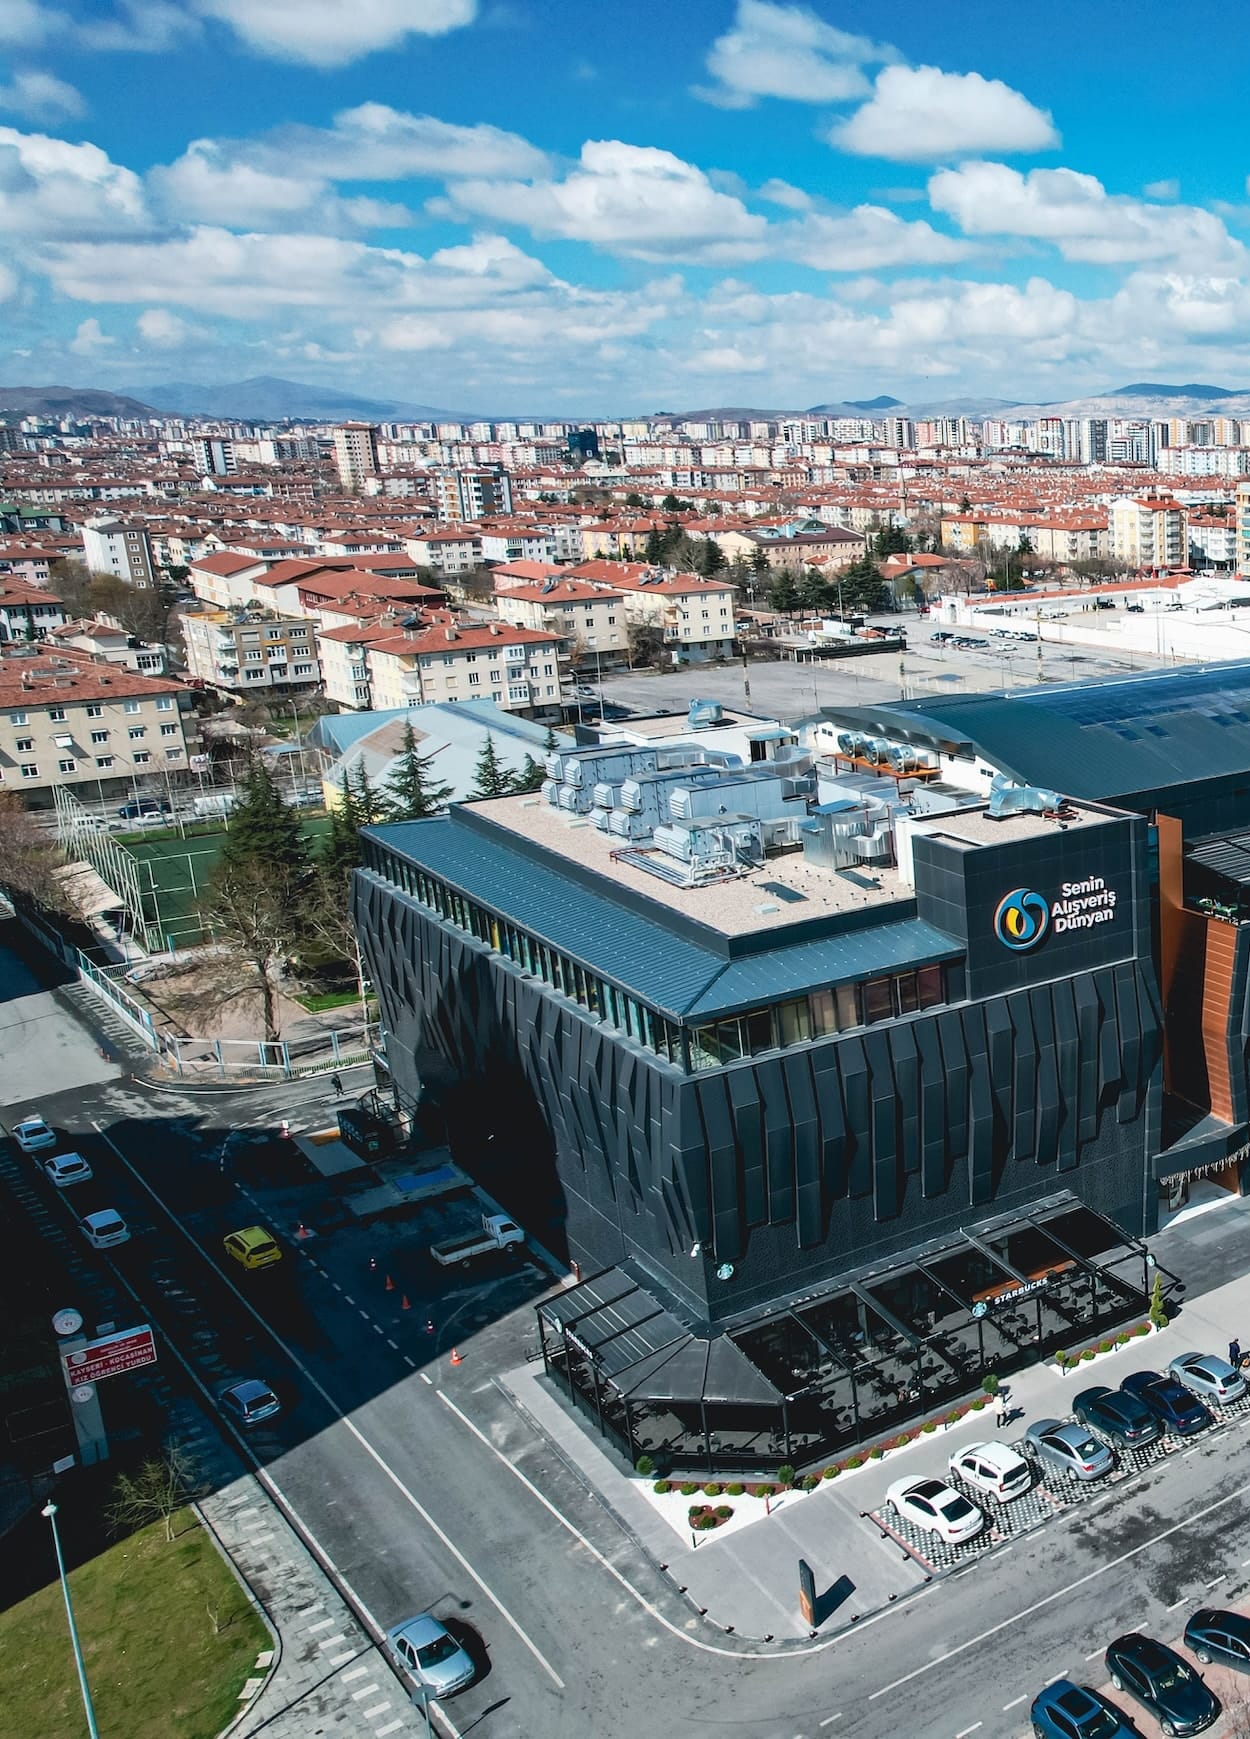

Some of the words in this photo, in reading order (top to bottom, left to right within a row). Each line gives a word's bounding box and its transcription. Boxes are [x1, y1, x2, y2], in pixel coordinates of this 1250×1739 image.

[1062, 875, 1105, 897] Senin
[1051, 889, 1117, 917] Alışveriş
[1055, 908, 1113, 933] Dünyan
[994, 1276, 1049, 1305] STARBUCKS
[126, 1355, 152, 1368] YURDU
